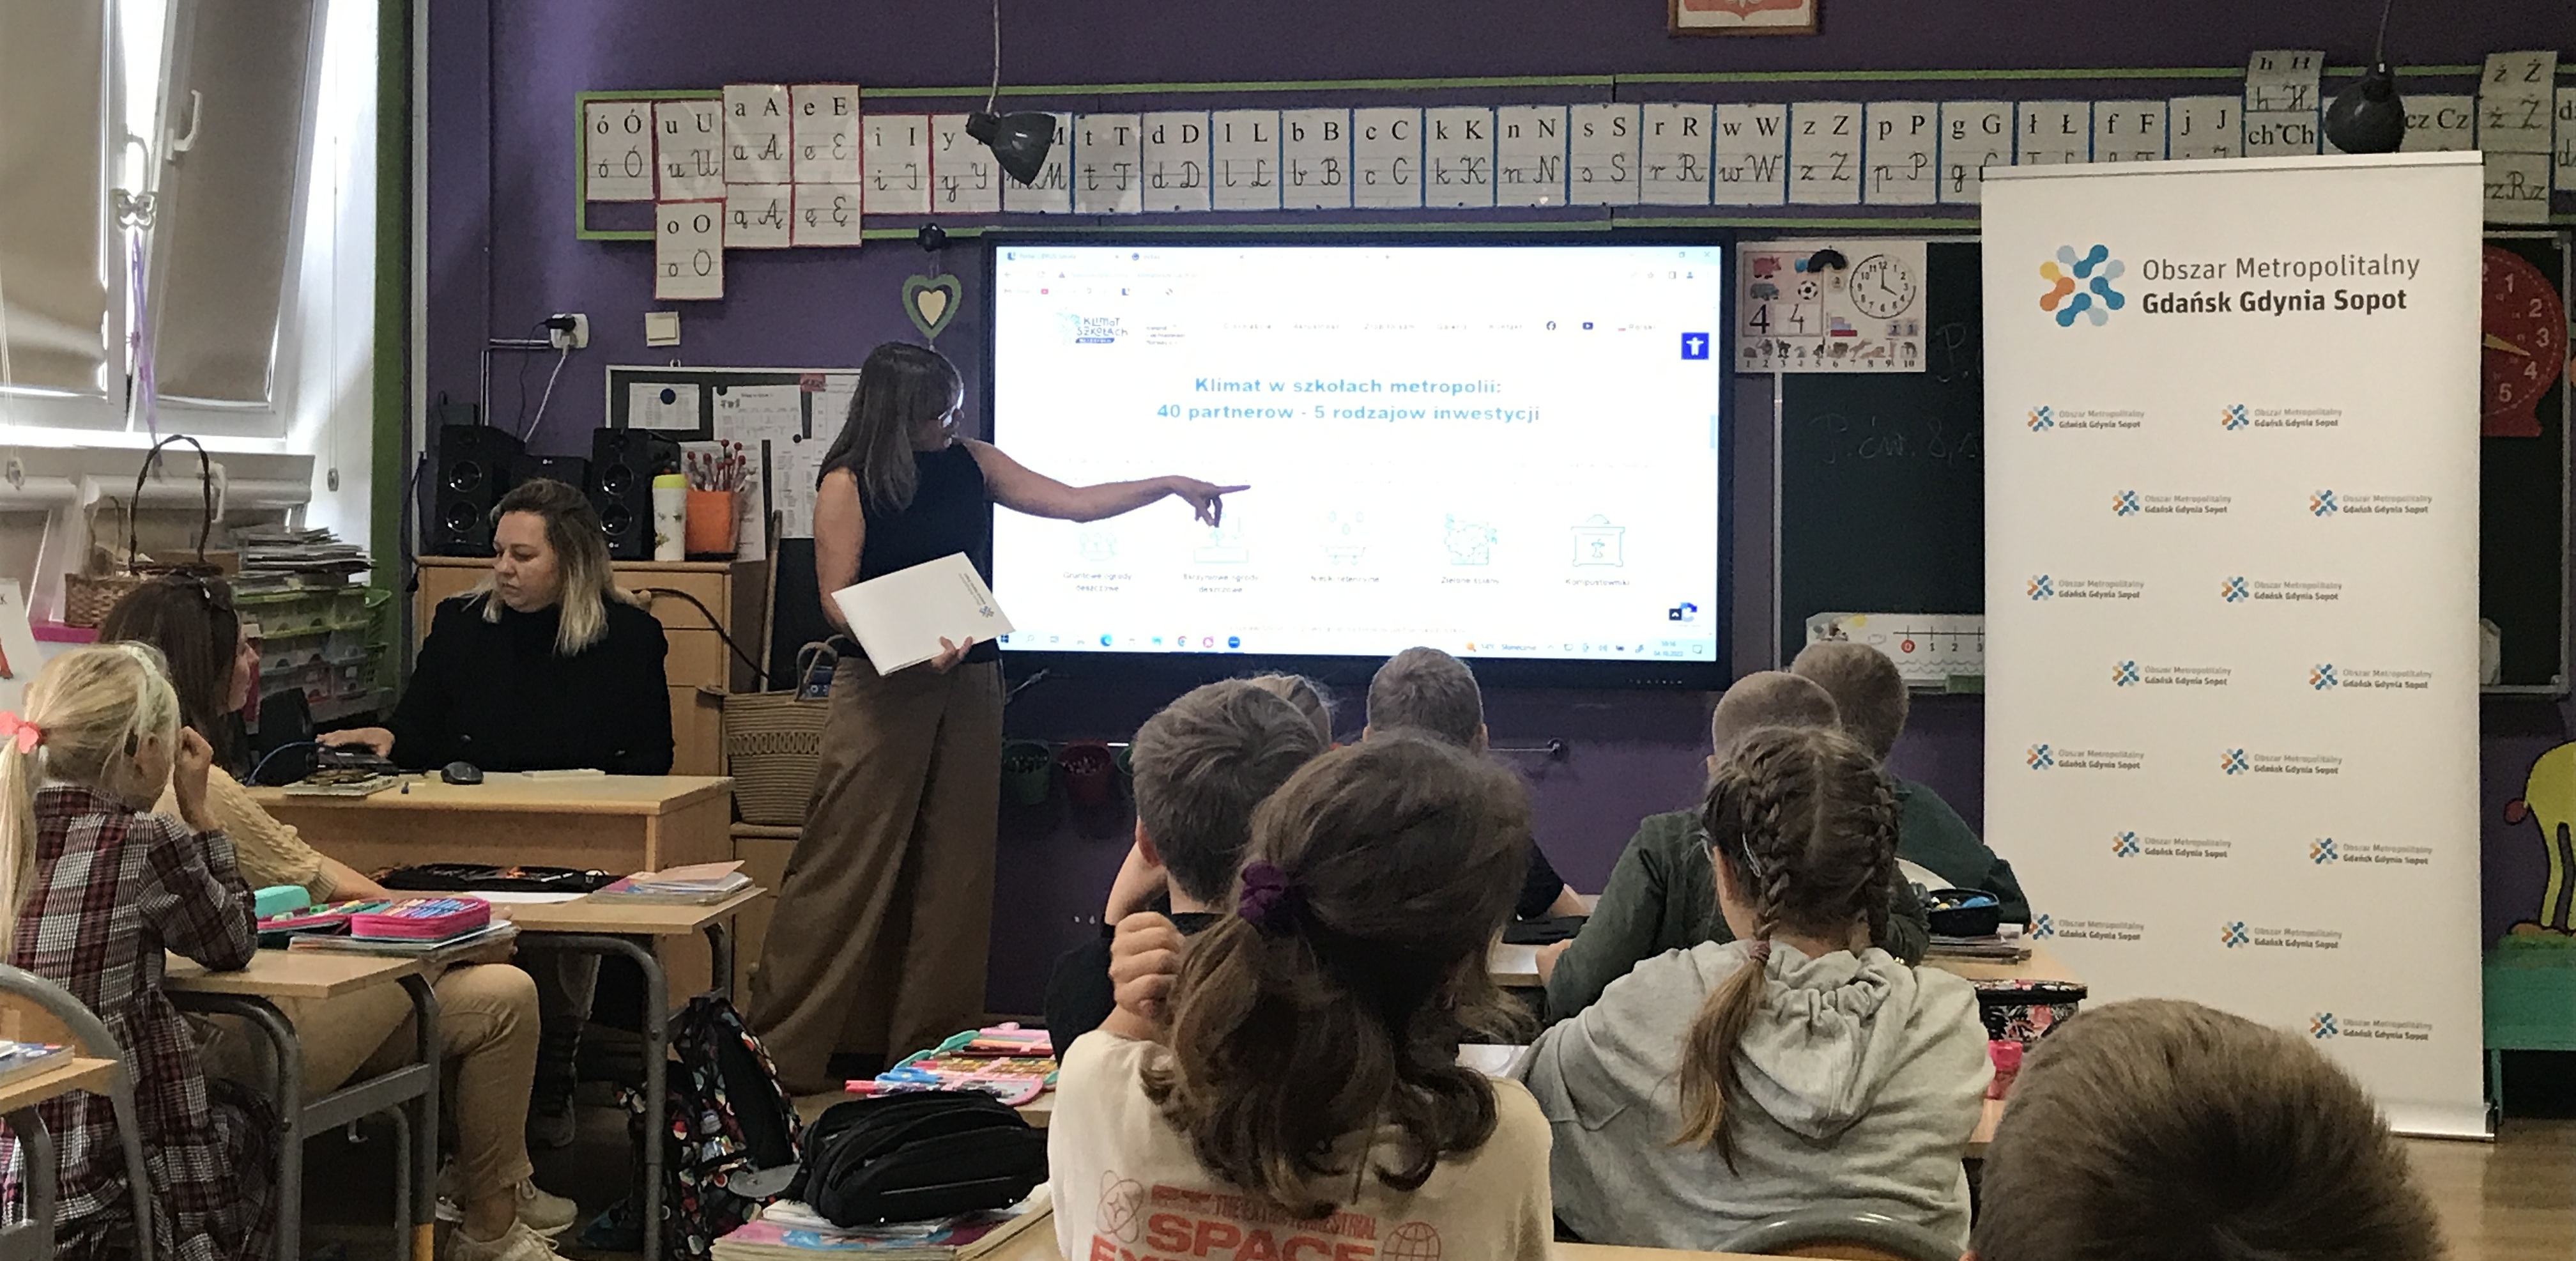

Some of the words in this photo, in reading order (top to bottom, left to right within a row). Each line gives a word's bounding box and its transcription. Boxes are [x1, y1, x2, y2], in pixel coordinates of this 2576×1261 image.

[2524, 59, 2542, 82] Ż
[735, 104, 746, 116] a
[764, 98, 779, 116] A
[804, 103, 815, 115] e
[833, 98, 845, 115] E
[597, 115, 608, 134] ó
[624, 109, 641, 134] Ó
[666, 121, 677, 134] u
[696, 114, 712, 132] U
[1508, 125, 1519, 137] n
[1538, 119, 1556, 137] N
[1584, 123, 1593, 136] s
[1613, 118, 1625, 136] S
[1656, 122, 1664, 135] r
[1683, 118, 1698, 136] R
[1723, 123, 1742, 135] w
[1756, 117, 1779, 135] W
[1804, 121, 1815, 134] z
[1833, 116, 1848, 135] Z
[1879, 121, 1892, 140] p
[1912, 116, 1924, 134] P
[1952, 121, 1965, 139] g
[1982, 114, 2000, 134] G
[2062, 114, 2076, 134] Ł
[2108, 113, 2119, 134] f
[2141, 114, 2154, 133] F
[2181, 109, 2190, 136] j
[2216, 109, 2227, 130] J
[2405, 113, 2429, 128] cz
[2437, 109, 2468, 129] Cz
[875, 127, 881, 146] i
[1085, 130, 1092, 146] t
[1114, 127, 1129, 146] T
[1153, 125, 1165, 144] d
[1183, 125, 1199, 143] D
[1254, 123, 1267, 141] L
[1292, 122, 1304, 141] b
[1325, 122, 1338, 140] B
[1366, 127, 1376, 139] c
[1392, 121, 1407, 139] C
[1437, 120, 1448, 139] k
[1466, 121, 1483, 139] K
[2249, 125, 2273, 144] ch
[2283, 125, 2313, 144] Ch
[943, 133, 955, 151] y
[2143, 259, 2227, 281] Obszar
[2236, 253, 2420, 281] Metropolitalny
[2505, 274, 2514, 293] 1
[2143, 291, 2232, 314] Gdańsk
[2240, 290, 2326, 316] Gdynia
[2334, 290, 2407, 315] Sopot
[2529, 299, 2542, 318] 2
[1749, 304, 1770, 334] 4
[1790, 304, 1804, 334] 4
[2536, 328, 2549, 348] 3
[2524, 362, 2537, 380] 4
[1195, 378, 1261, 392] Klimat
[1270, 382, 1285, 392] w
[1294, 378, 1382, 394] szkołach
[1390, 380, 1501, 396] metropolii:
[2499, 383, 2511, 402] 5
[1158, 404, 1181, 419] 40
[1189, 405, 1294, 421] partnerow
[1314, 405, 1325, 419] 5
[1333, 405, 1426, 422] rodzajow
[1434, 406, 1539, 423] inwestycji
[1930, 643, 1935, 651] 1
[1952, 643, 1958, 651] 2
